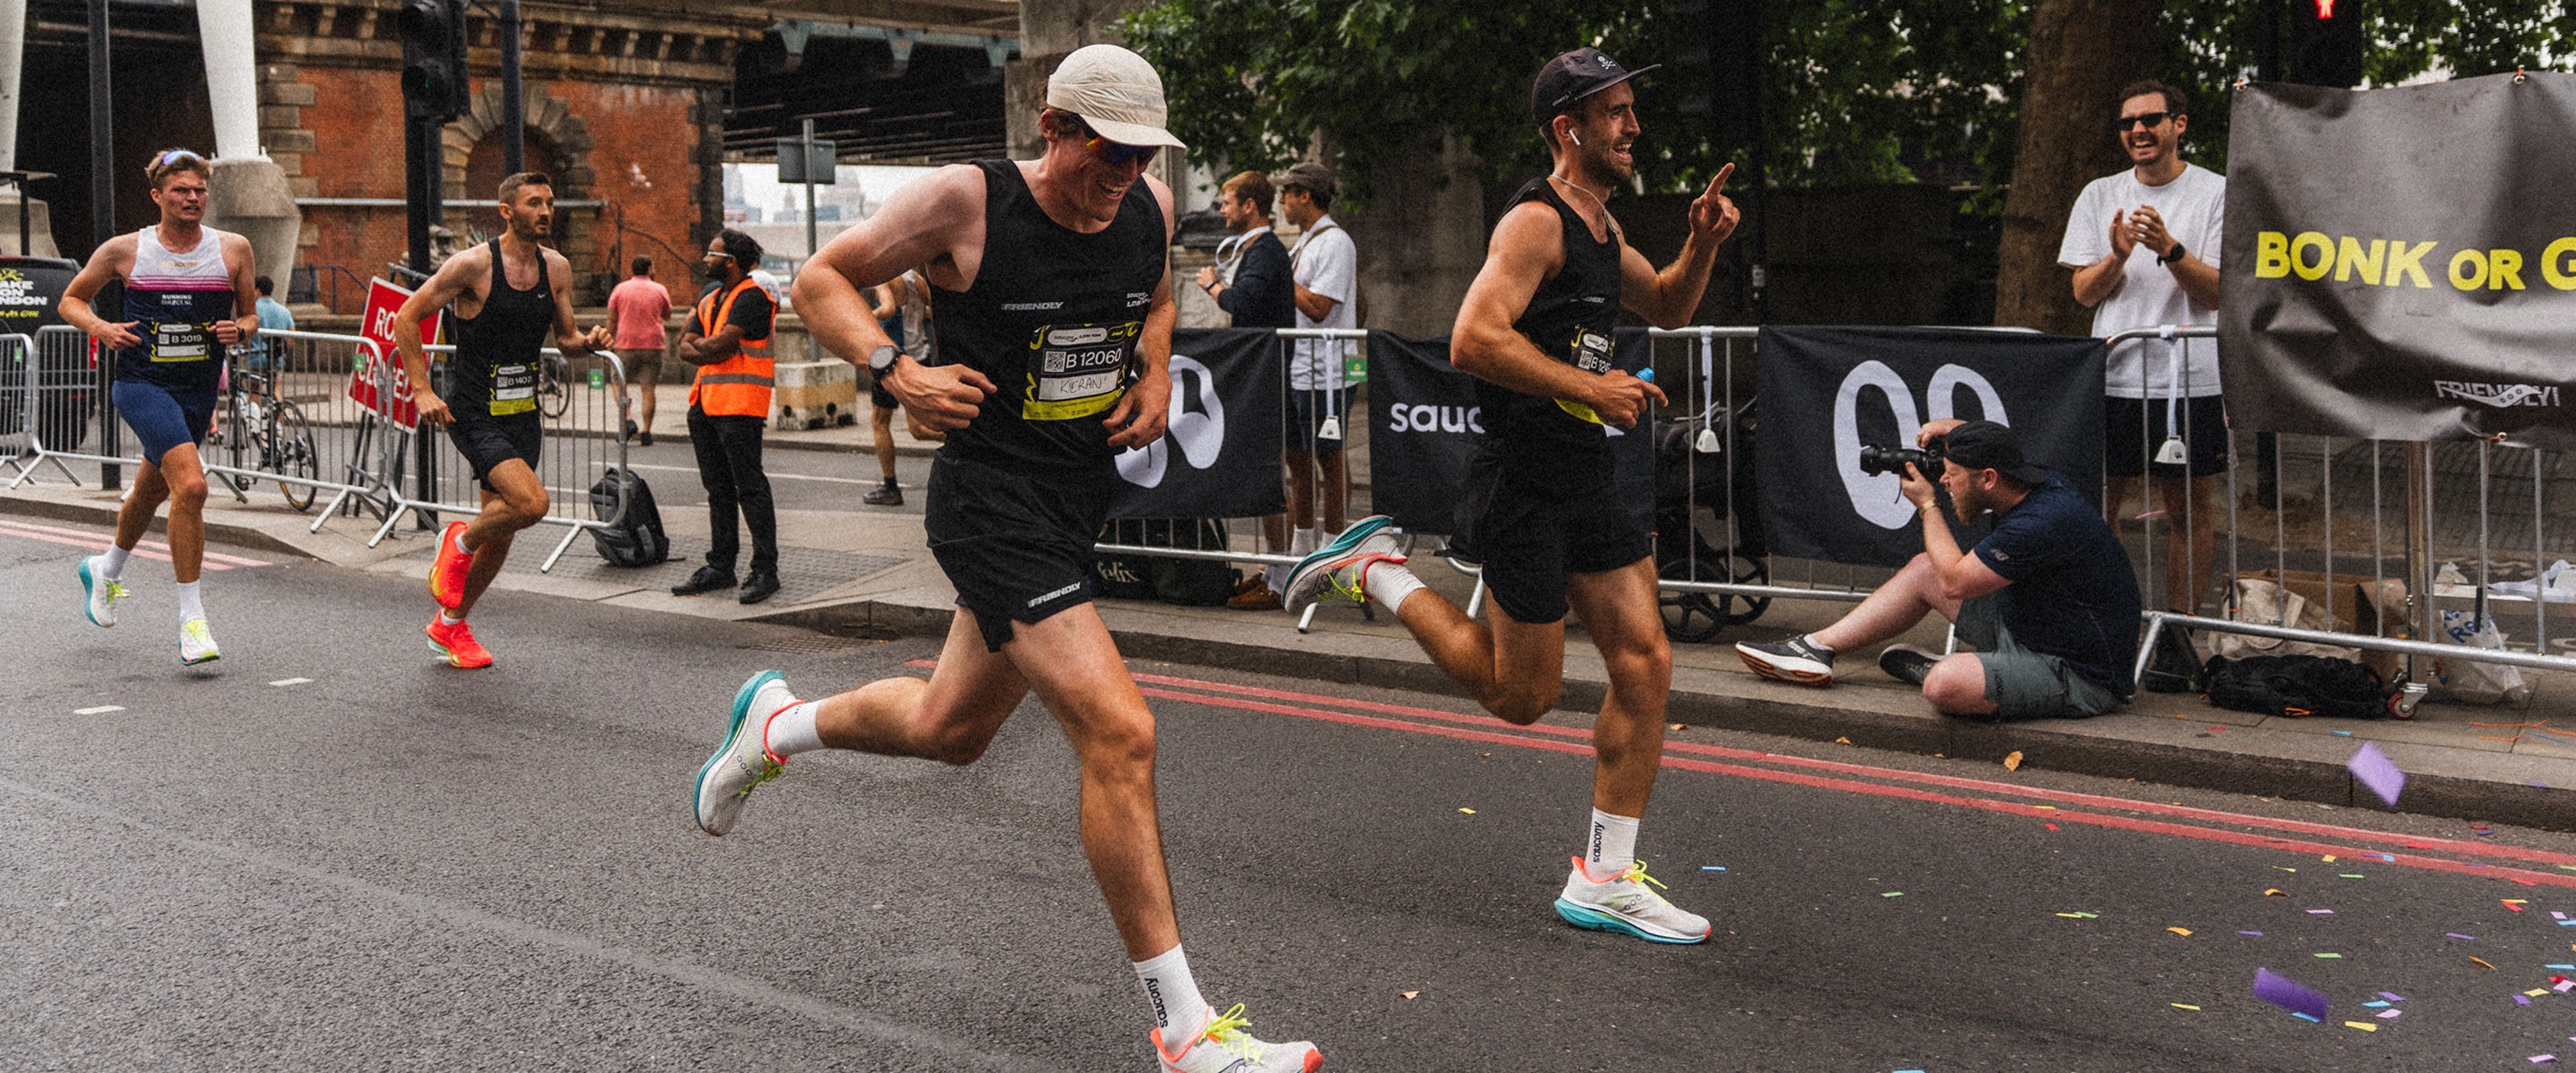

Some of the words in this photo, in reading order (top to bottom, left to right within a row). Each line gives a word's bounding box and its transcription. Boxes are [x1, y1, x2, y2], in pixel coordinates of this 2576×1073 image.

[2255, 231, 2438, 288] BONK
[2449, 249, 2526, 291] OR
[172, 335, 179, 343] B
[180, 334, 202, 343] 3019
[374, 306, 398, 343] RO
[1066, 353, 1077, 369] B
[1080, 348, 1122, 366] 12060
[1591, 356, 1598, 369] B
[508, 378, 515, 386] B
[1389, 402, 1486, 434] sauc
[1593, 822, 1605, 863] saucony
[1144, 978, 1169, 1028] saucony
